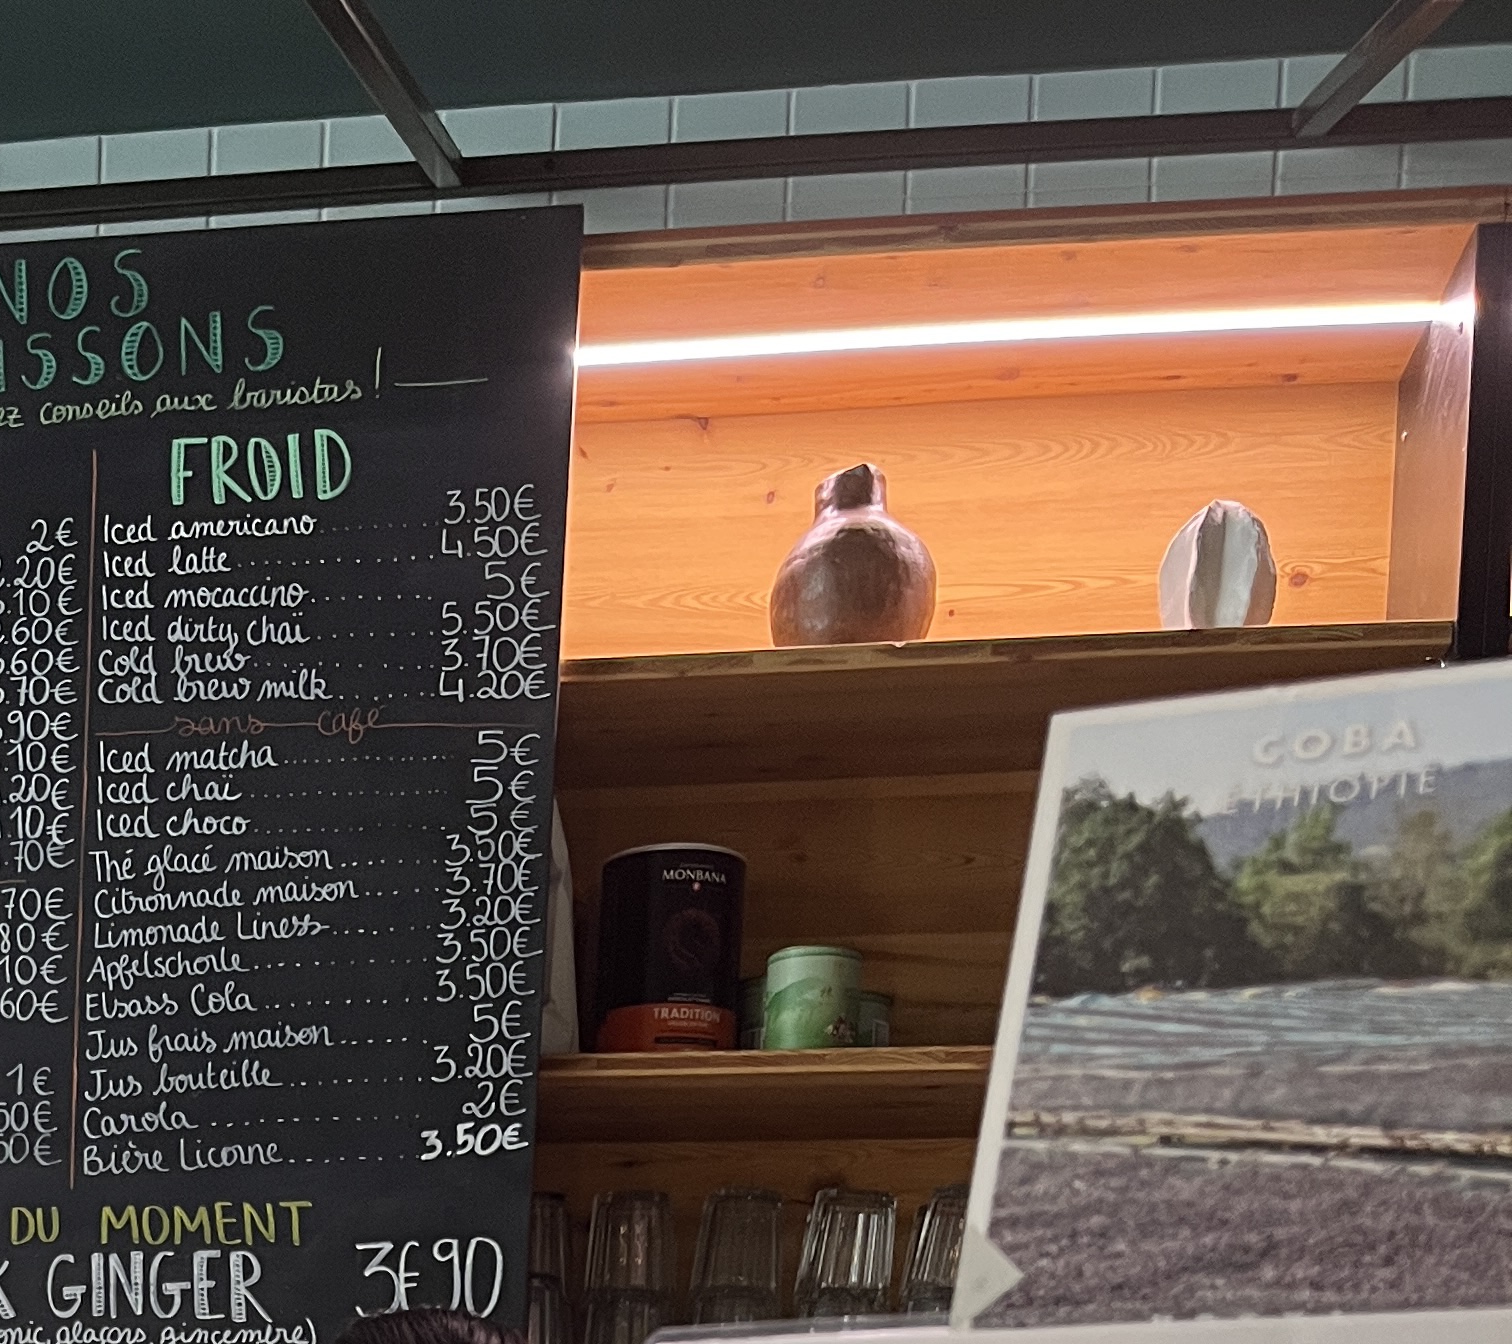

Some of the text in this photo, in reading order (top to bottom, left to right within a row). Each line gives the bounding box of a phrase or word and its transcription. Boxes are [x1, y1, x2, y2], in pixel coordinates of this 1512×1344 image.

[40, 391, 143, 424] conseils
[151, 394, 217, 418] aux
[228, 377, 362, 409] baristas
[171, 429, 351, 505] FROID
[26, 518, 78, 553] 2€
[104, 515, 157, 544] Iced
[168, 514, 316, 540] americano
[99, 674, 158, 703] Cold
[171, 669, 251, 702] brew
[257, 669, 333, 701] milk
[1254, 720, 1417, 765] COBA
[662, 868, 727, 885] MONBANA
[95, 916, 225, 948] Limonade
[87, 947, 249, 990] Apfelschorle
[653, 1007, 720, 1024] TRADITION
[7, 1064, 54, 1095] 1€
[85, 1079, 526, 1139] Carola 2€
[84, 1122, 528, 1175] Bière Licorne 3.50€
[11, 1207, 59, 1245] DU
[101, 1201, 312, 1246] MOMENT
[48, 1250, 273, 1322] GINGER
